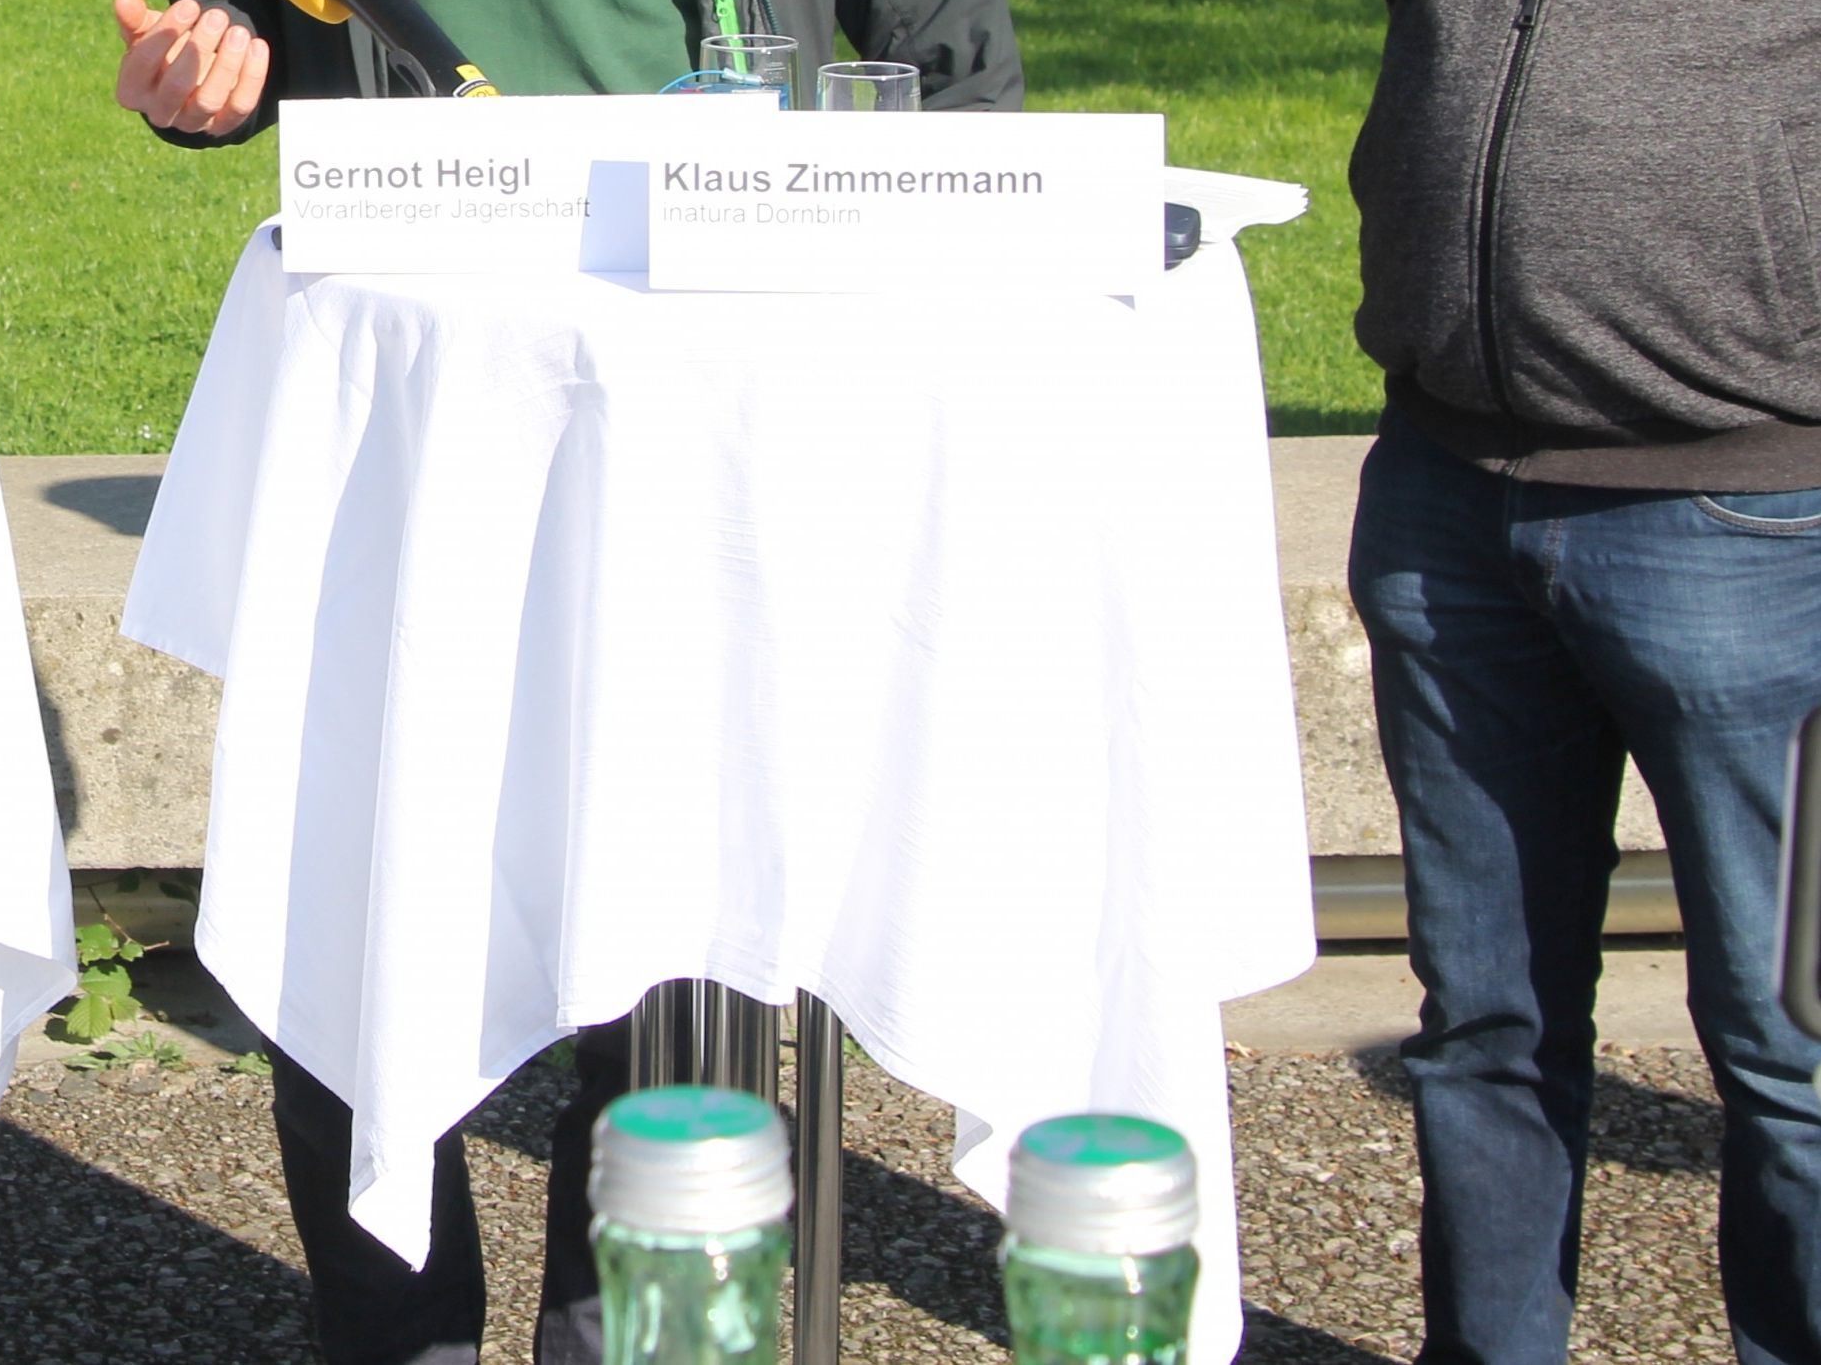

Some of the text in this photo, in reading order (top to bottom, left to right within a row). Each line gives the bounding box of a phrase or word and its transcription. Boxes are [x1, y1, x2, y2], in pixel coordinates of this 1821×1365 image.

[294, 158, 530, 195] Gernot Heigl
[664, 162, 1043, 194] Klaus Zimmermann
[294, 200, 441, 224] Vorarlberger
[664, 202, 861, 224] inatura Dornbirn
